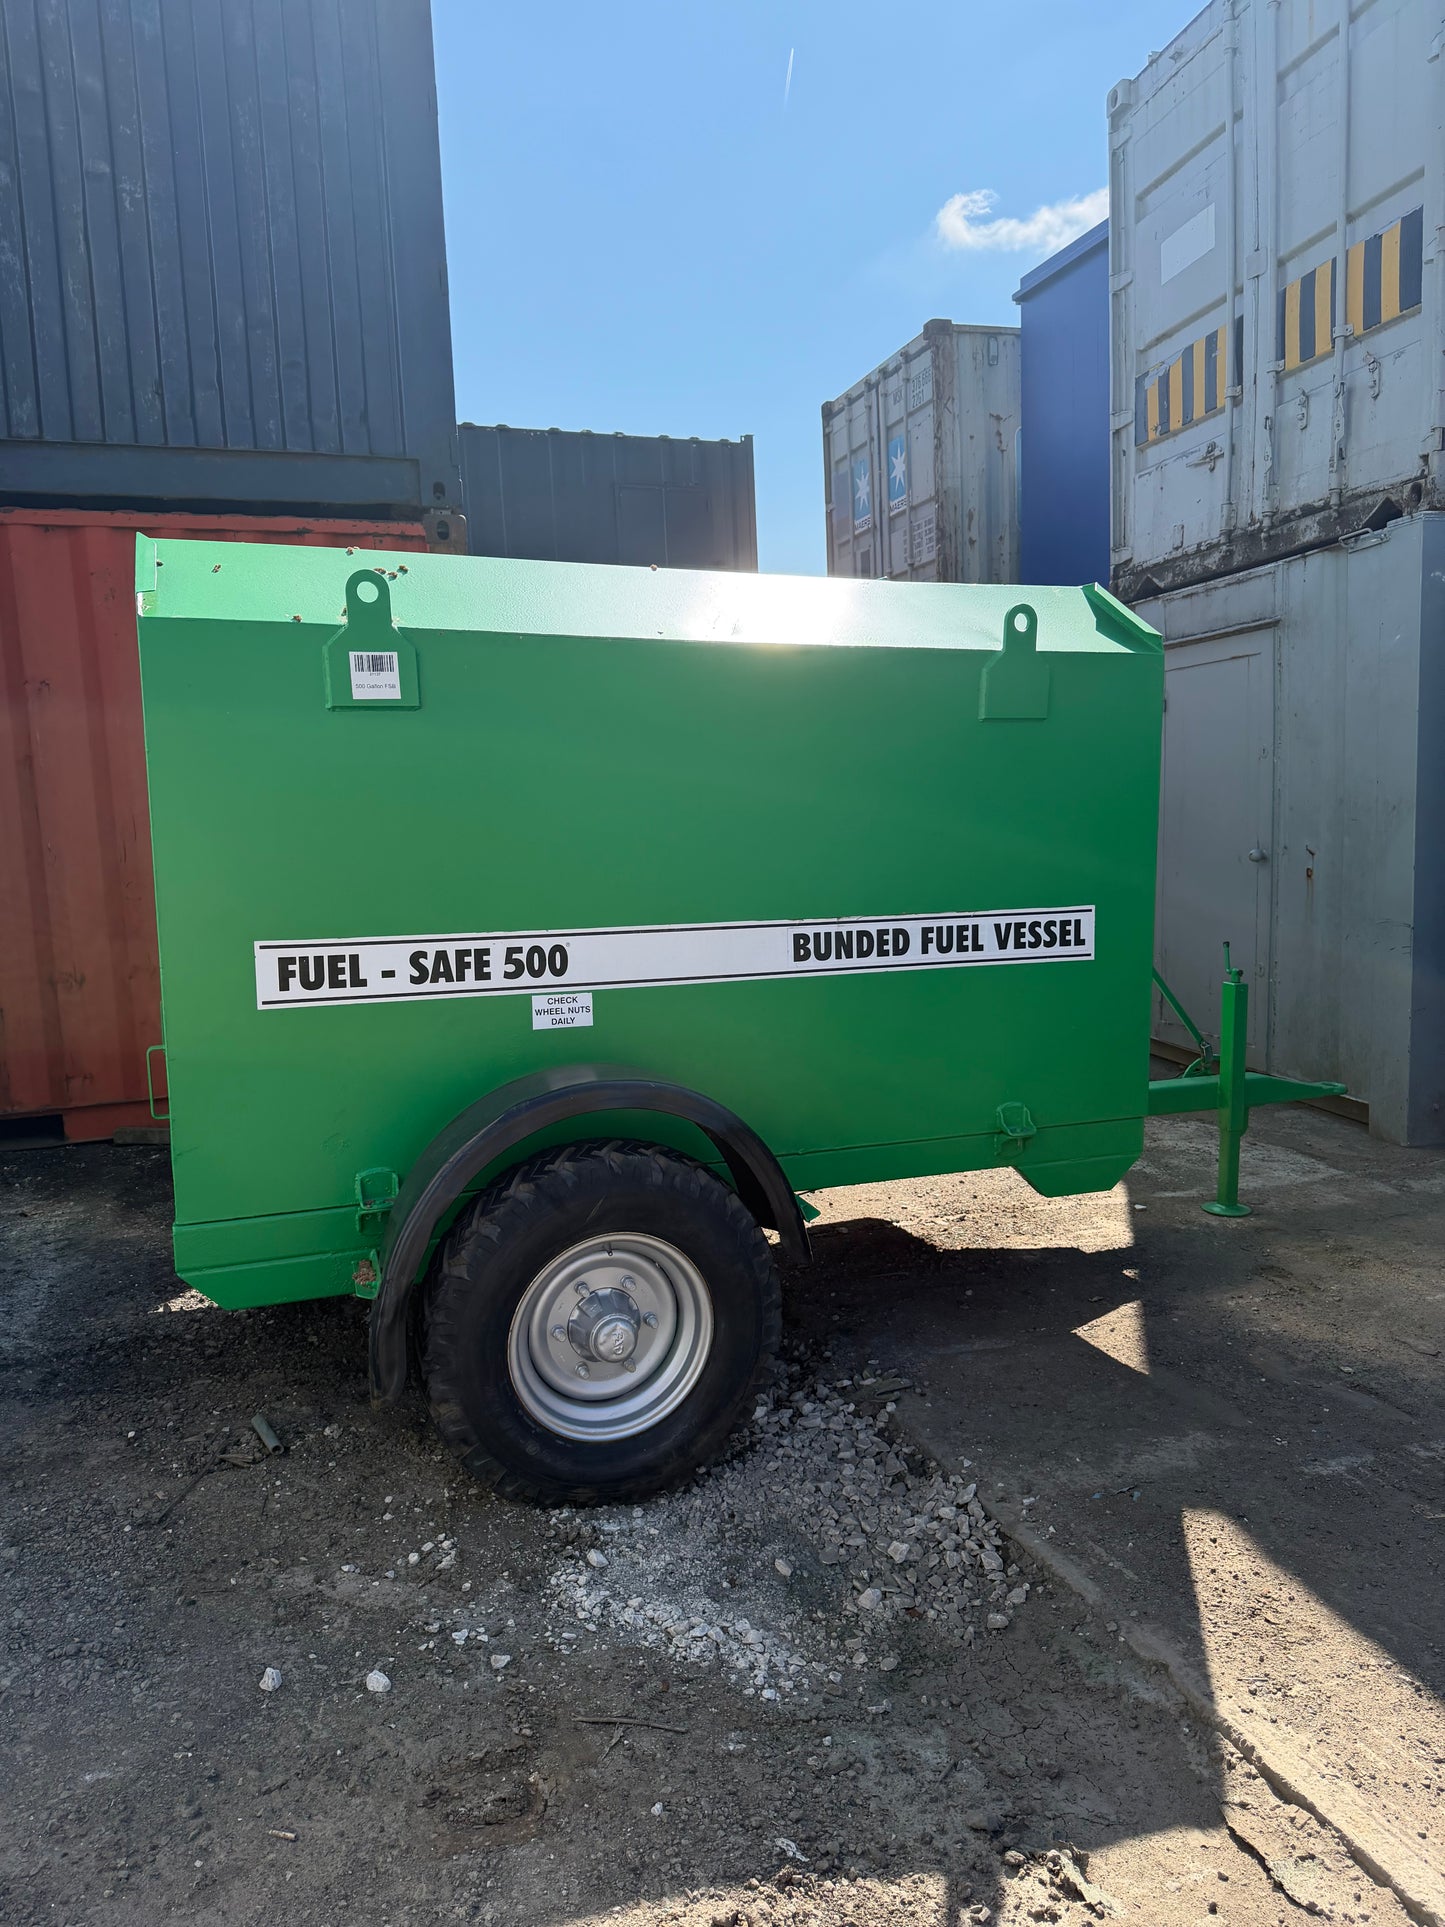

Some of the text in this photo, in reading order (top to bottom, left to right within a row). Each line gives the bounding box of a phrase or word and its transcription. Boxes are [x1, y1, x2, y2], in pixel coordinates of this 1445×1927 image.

[792, 918, 1086, 963] BUNDED FUEL VESSEL
[277, 953, 368, 992] FUEL
[409, 947, 492, 985] SAFE
[503, 943, 569, 980] 500
[547, 996, 578, 1006] CHECK
[535, 1005, 591, 1016] WHEEL NUTS
[551, 1016, 575, 1026] DAILY
